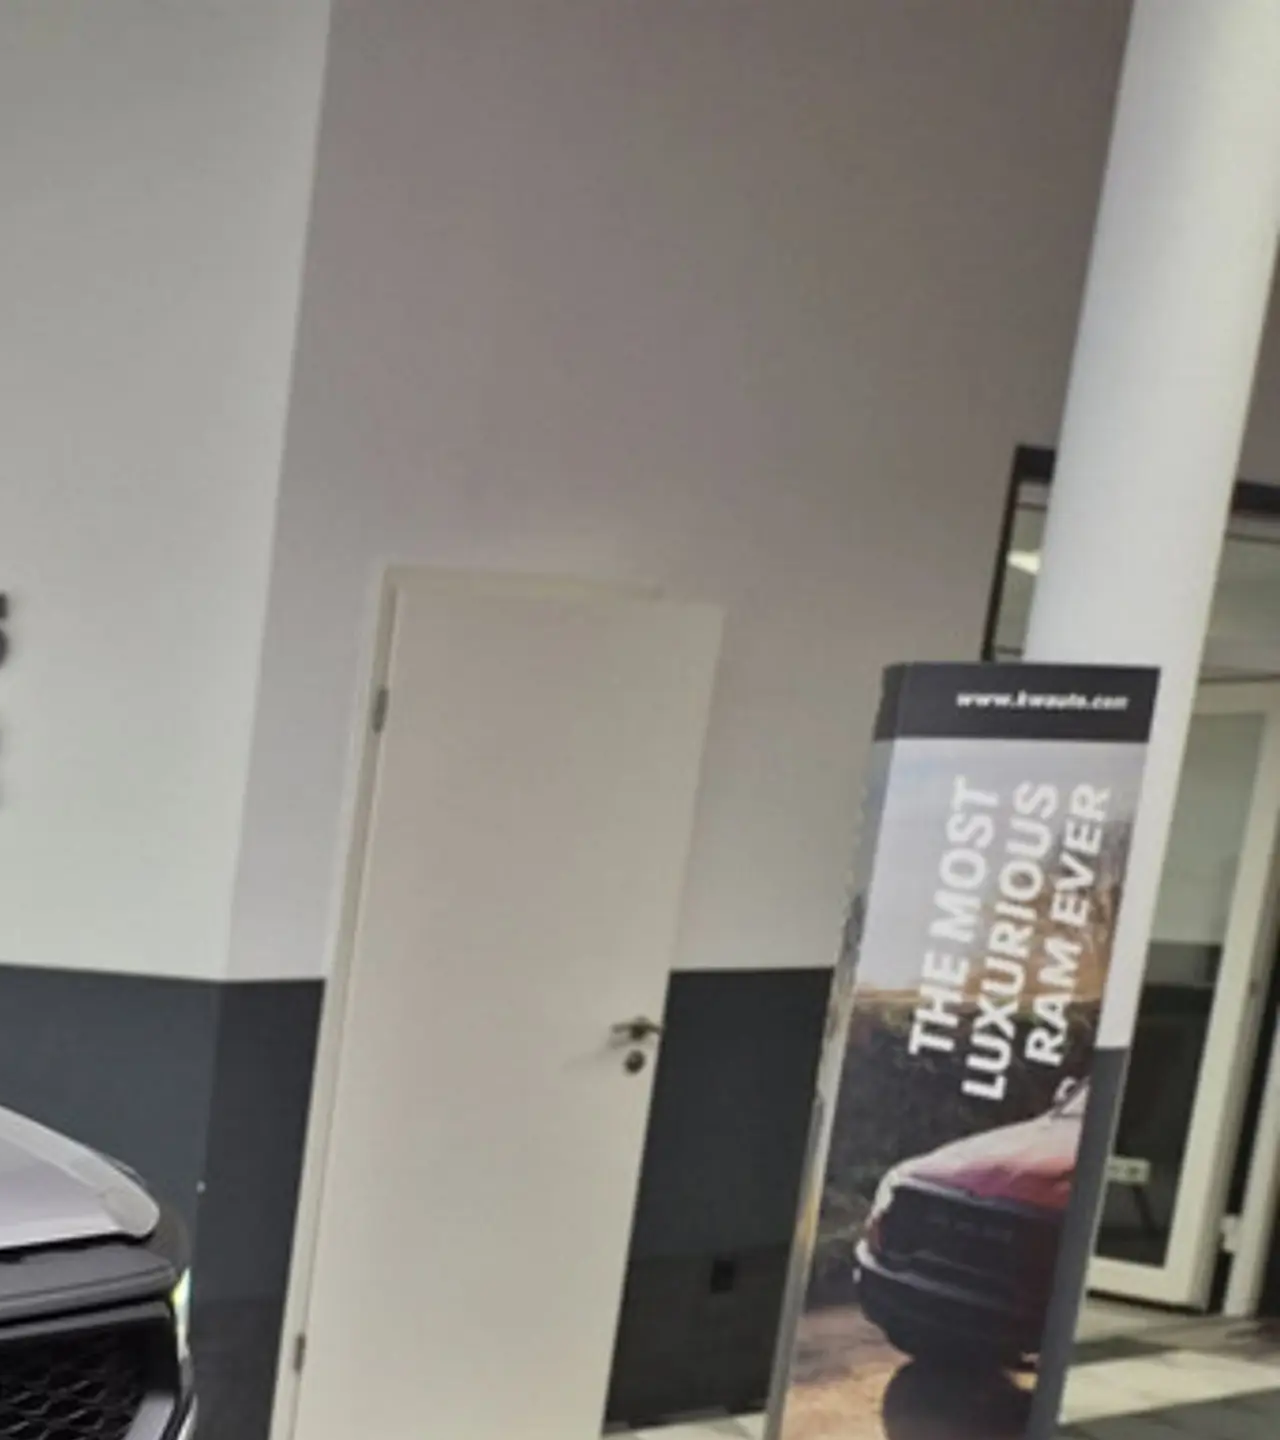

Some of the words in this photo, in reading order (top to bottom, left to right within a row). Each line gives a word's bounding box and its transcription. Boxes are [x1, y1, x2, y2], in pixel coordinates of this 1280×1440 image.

[956, 690, 1129, 711] www.kwauto.com
[929, 776, 998, 942] MOST
[1050, 784, 1111, 926] EVER
[908, 951, 968, 1054] THE
[961, 780, 1058, 1100] LUXURIOUS
[1024, 936, 1083, 1066] RAM
